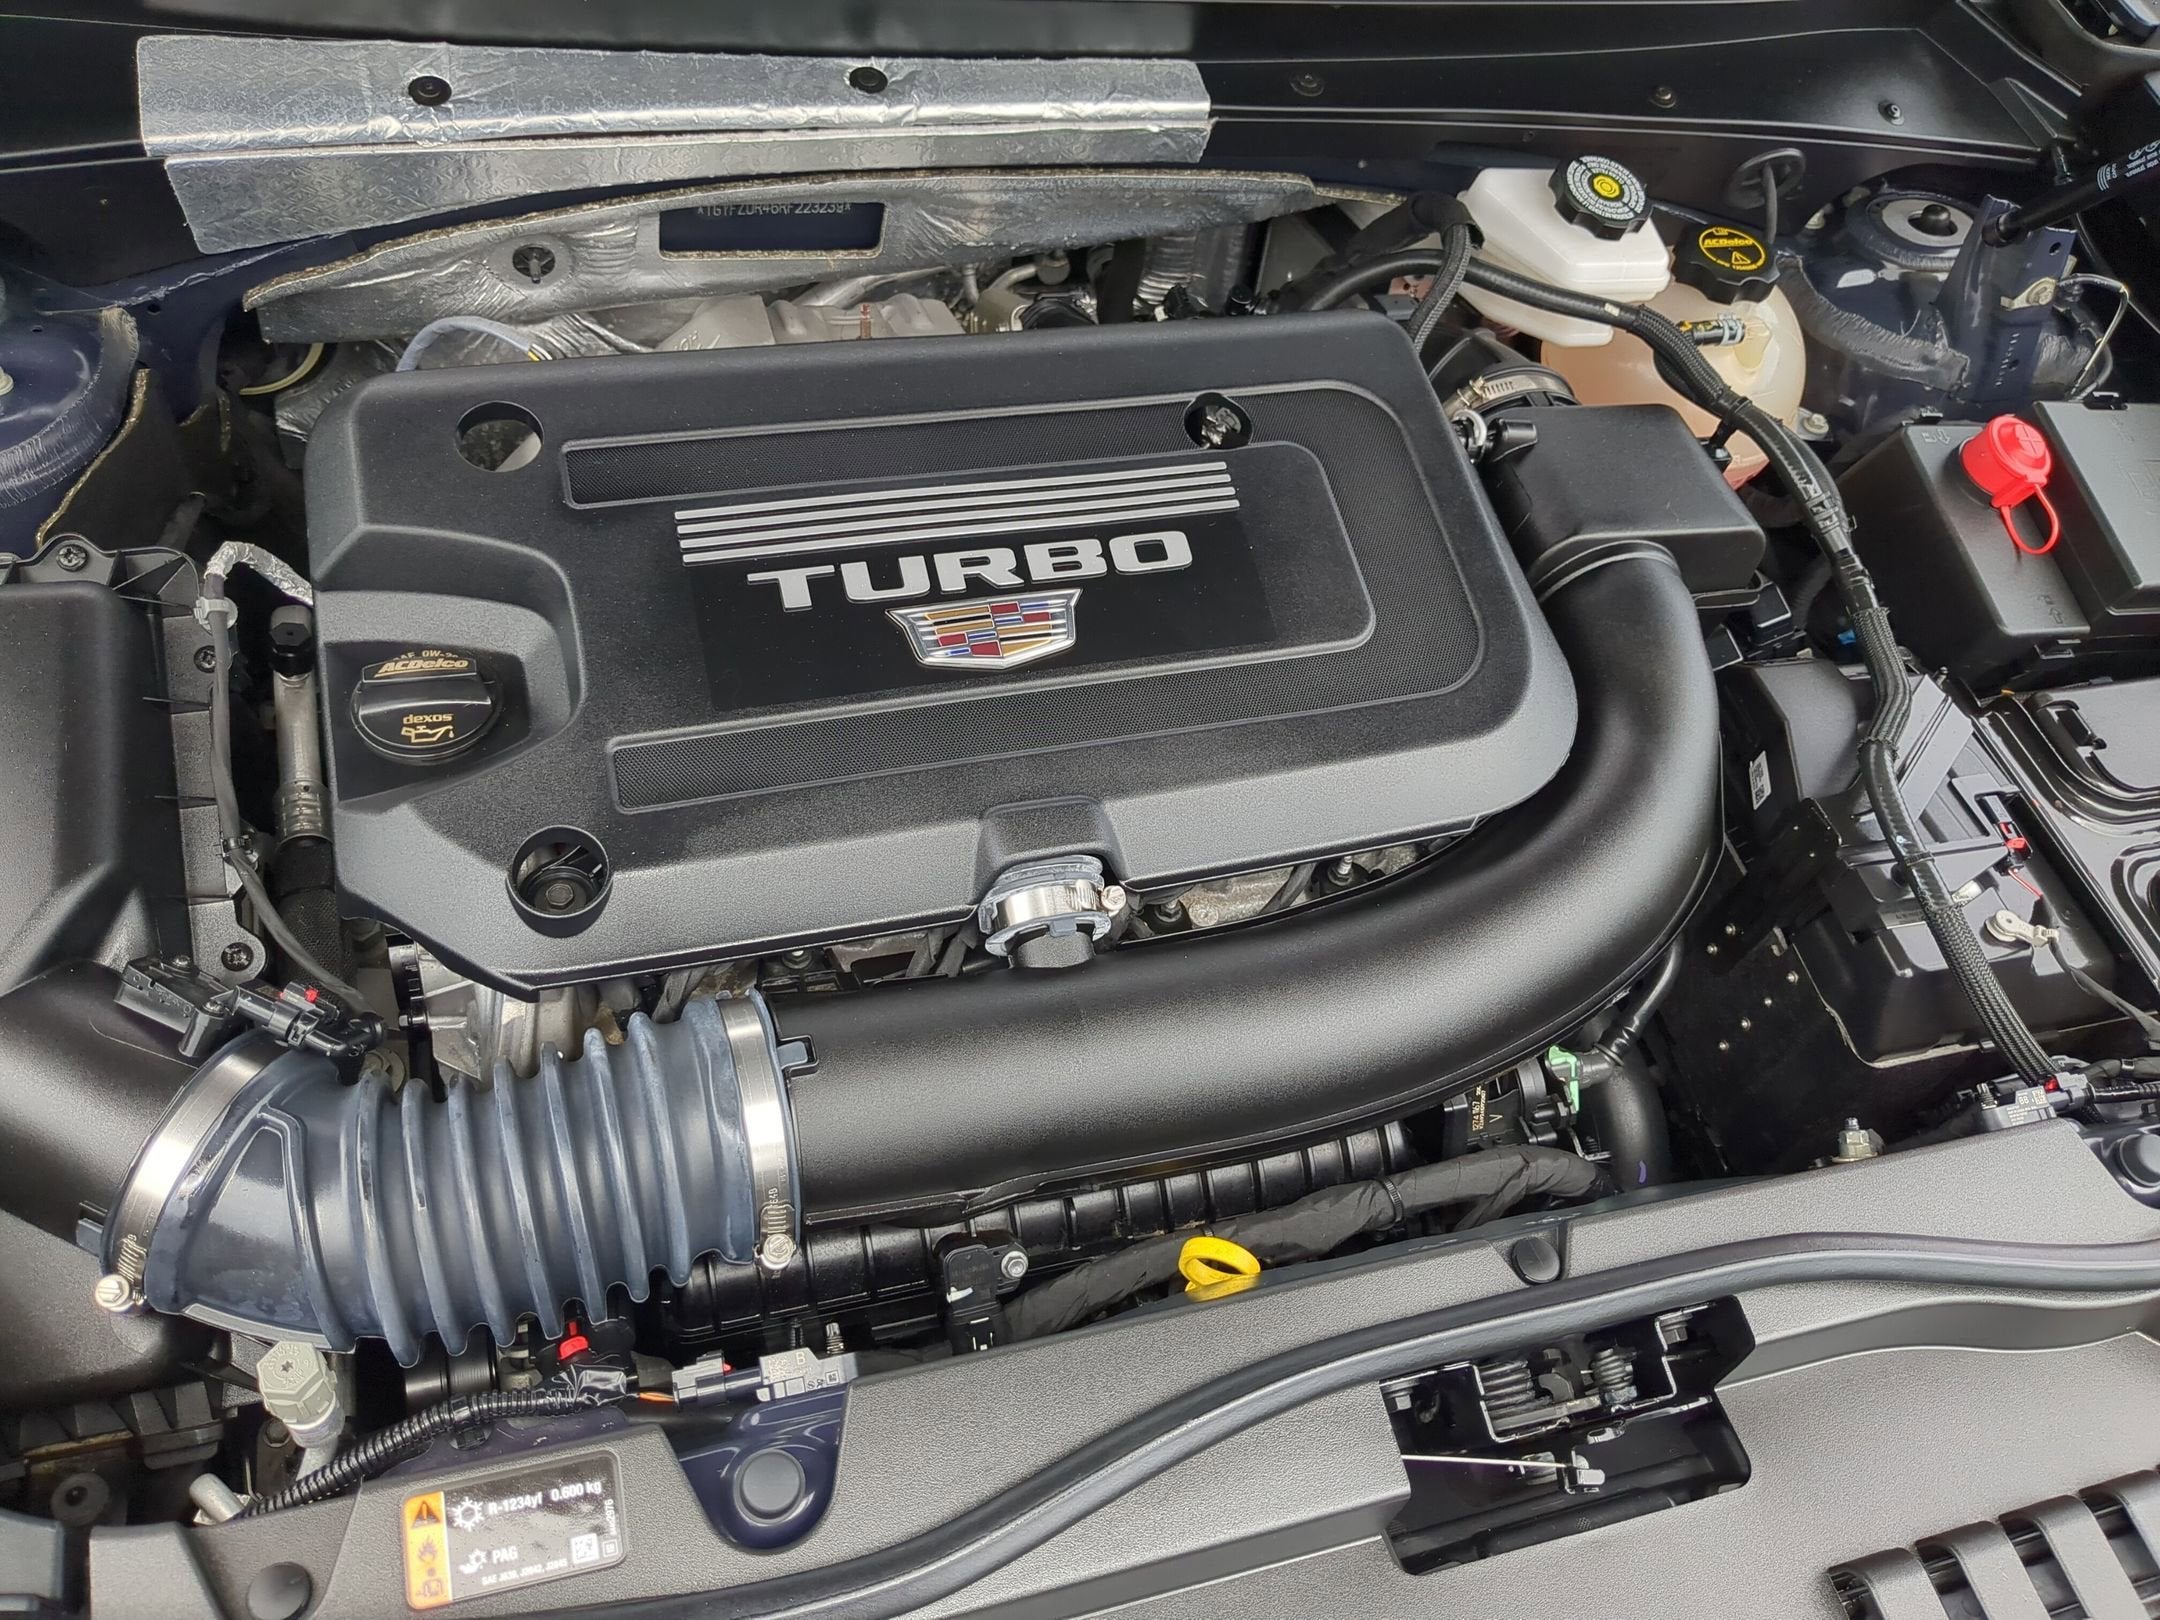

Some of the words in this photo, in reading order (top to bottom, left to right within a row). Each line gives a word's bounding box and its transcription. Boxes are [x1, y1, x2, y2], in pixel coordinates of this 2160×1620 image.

[747, 530, 1194, 613] TURBO
[378, 658, 469, 674] ACDelco
[403, 713, 454, 725] dexos
[488, 1491, 543, 1515] R-1234yf
[550, 1483, 584, 1502] 0.600
[585, 1481, 602, 1494] kg
[492, 1546, 518, 1564] PAG
